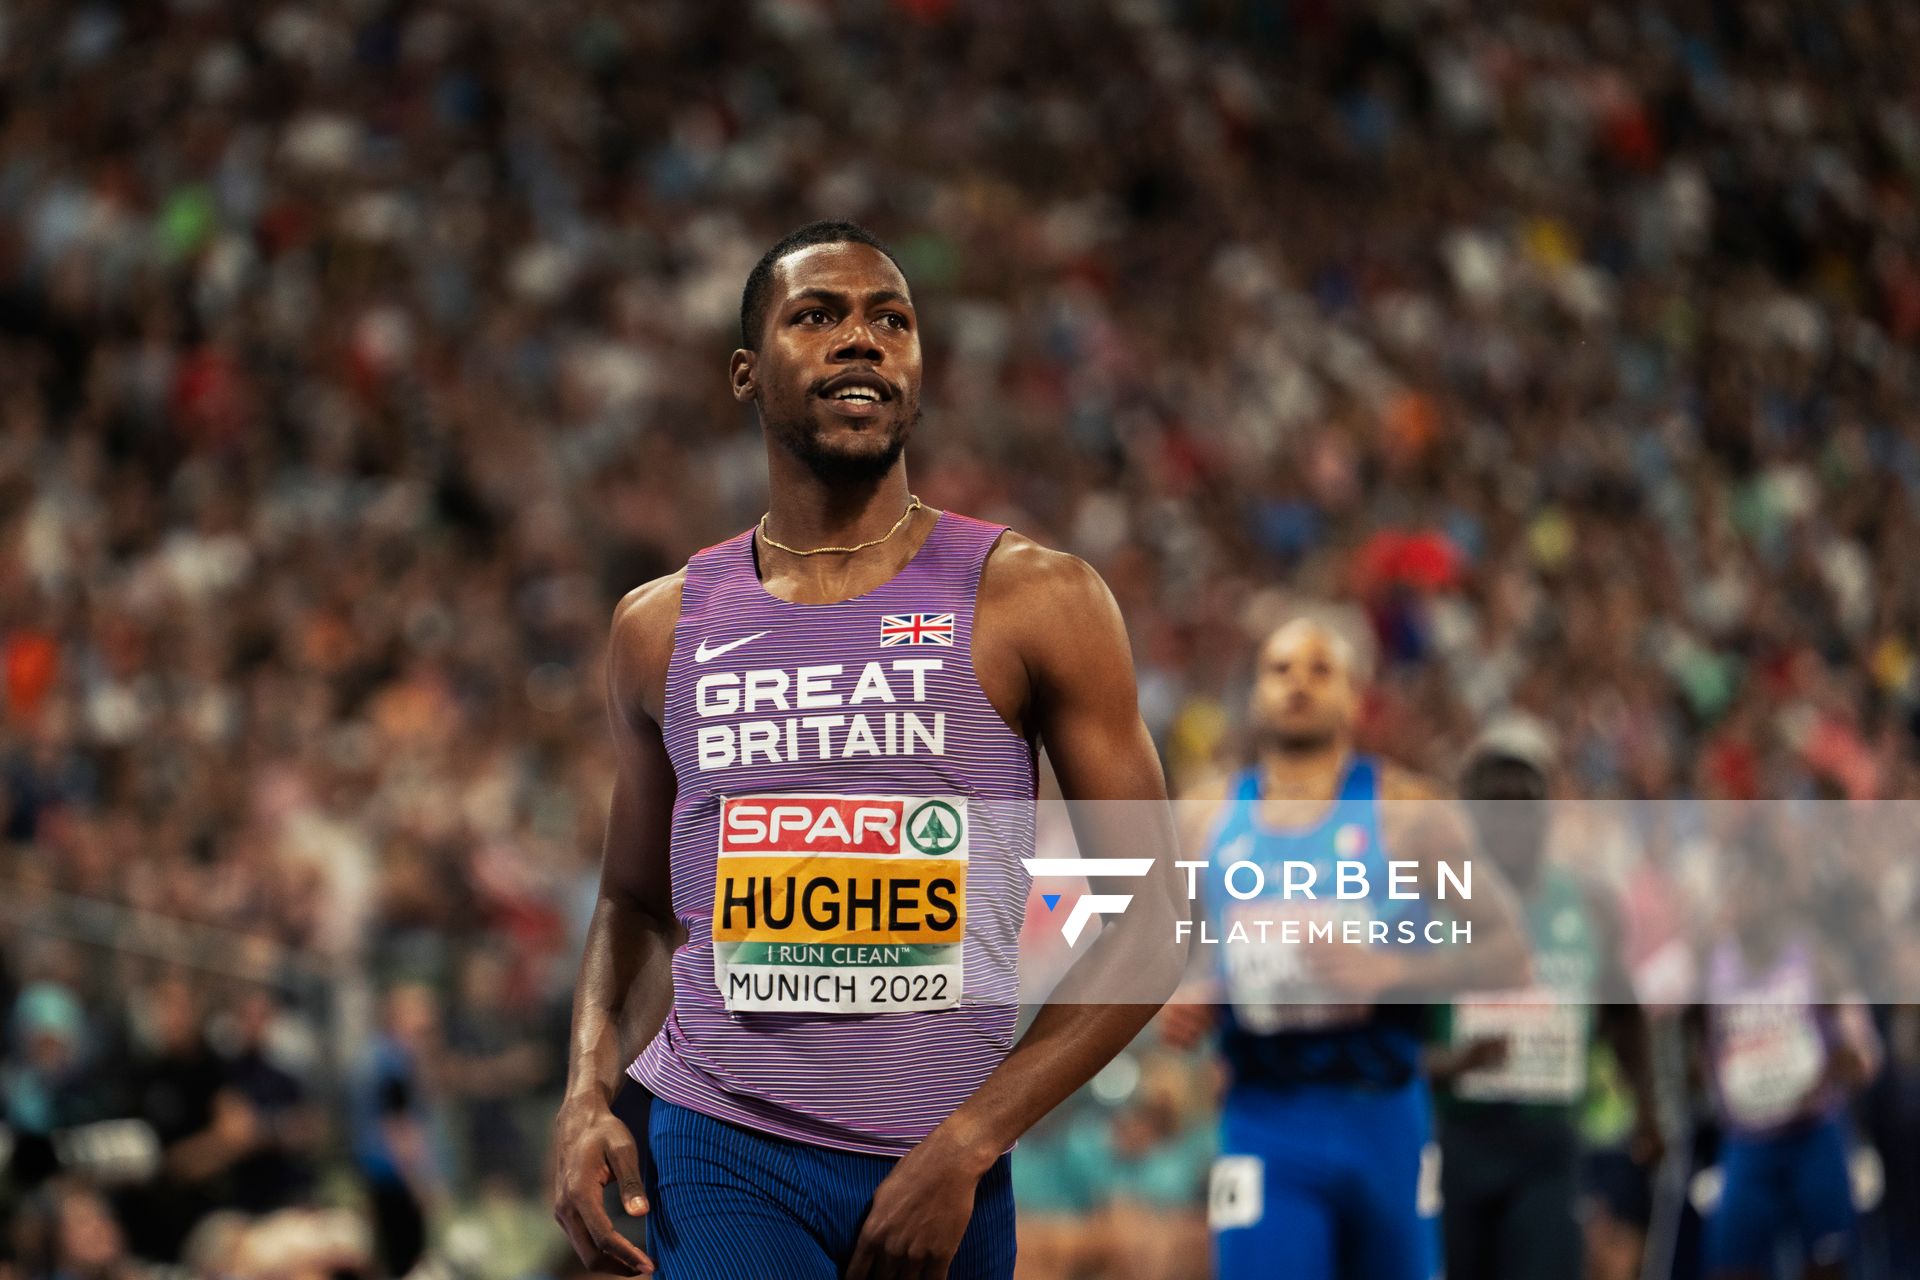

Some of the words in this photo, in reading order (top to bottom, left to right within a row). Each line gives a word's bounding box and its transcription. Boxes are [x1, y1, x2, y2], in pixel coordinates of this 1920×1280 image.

[696, 659, 943, 717] GREAT
[697, 712, 945, 770] BRITAIN
[727, 806, 896, 846] SPAR
[722, 876, 958, 932] HUGHES
[767, 945, 773, 963] I
[780, 946, 825, 964] RUN
[730, 972, 856, 1003] MUNICH
[870, 973, 948, 1003] 2022
